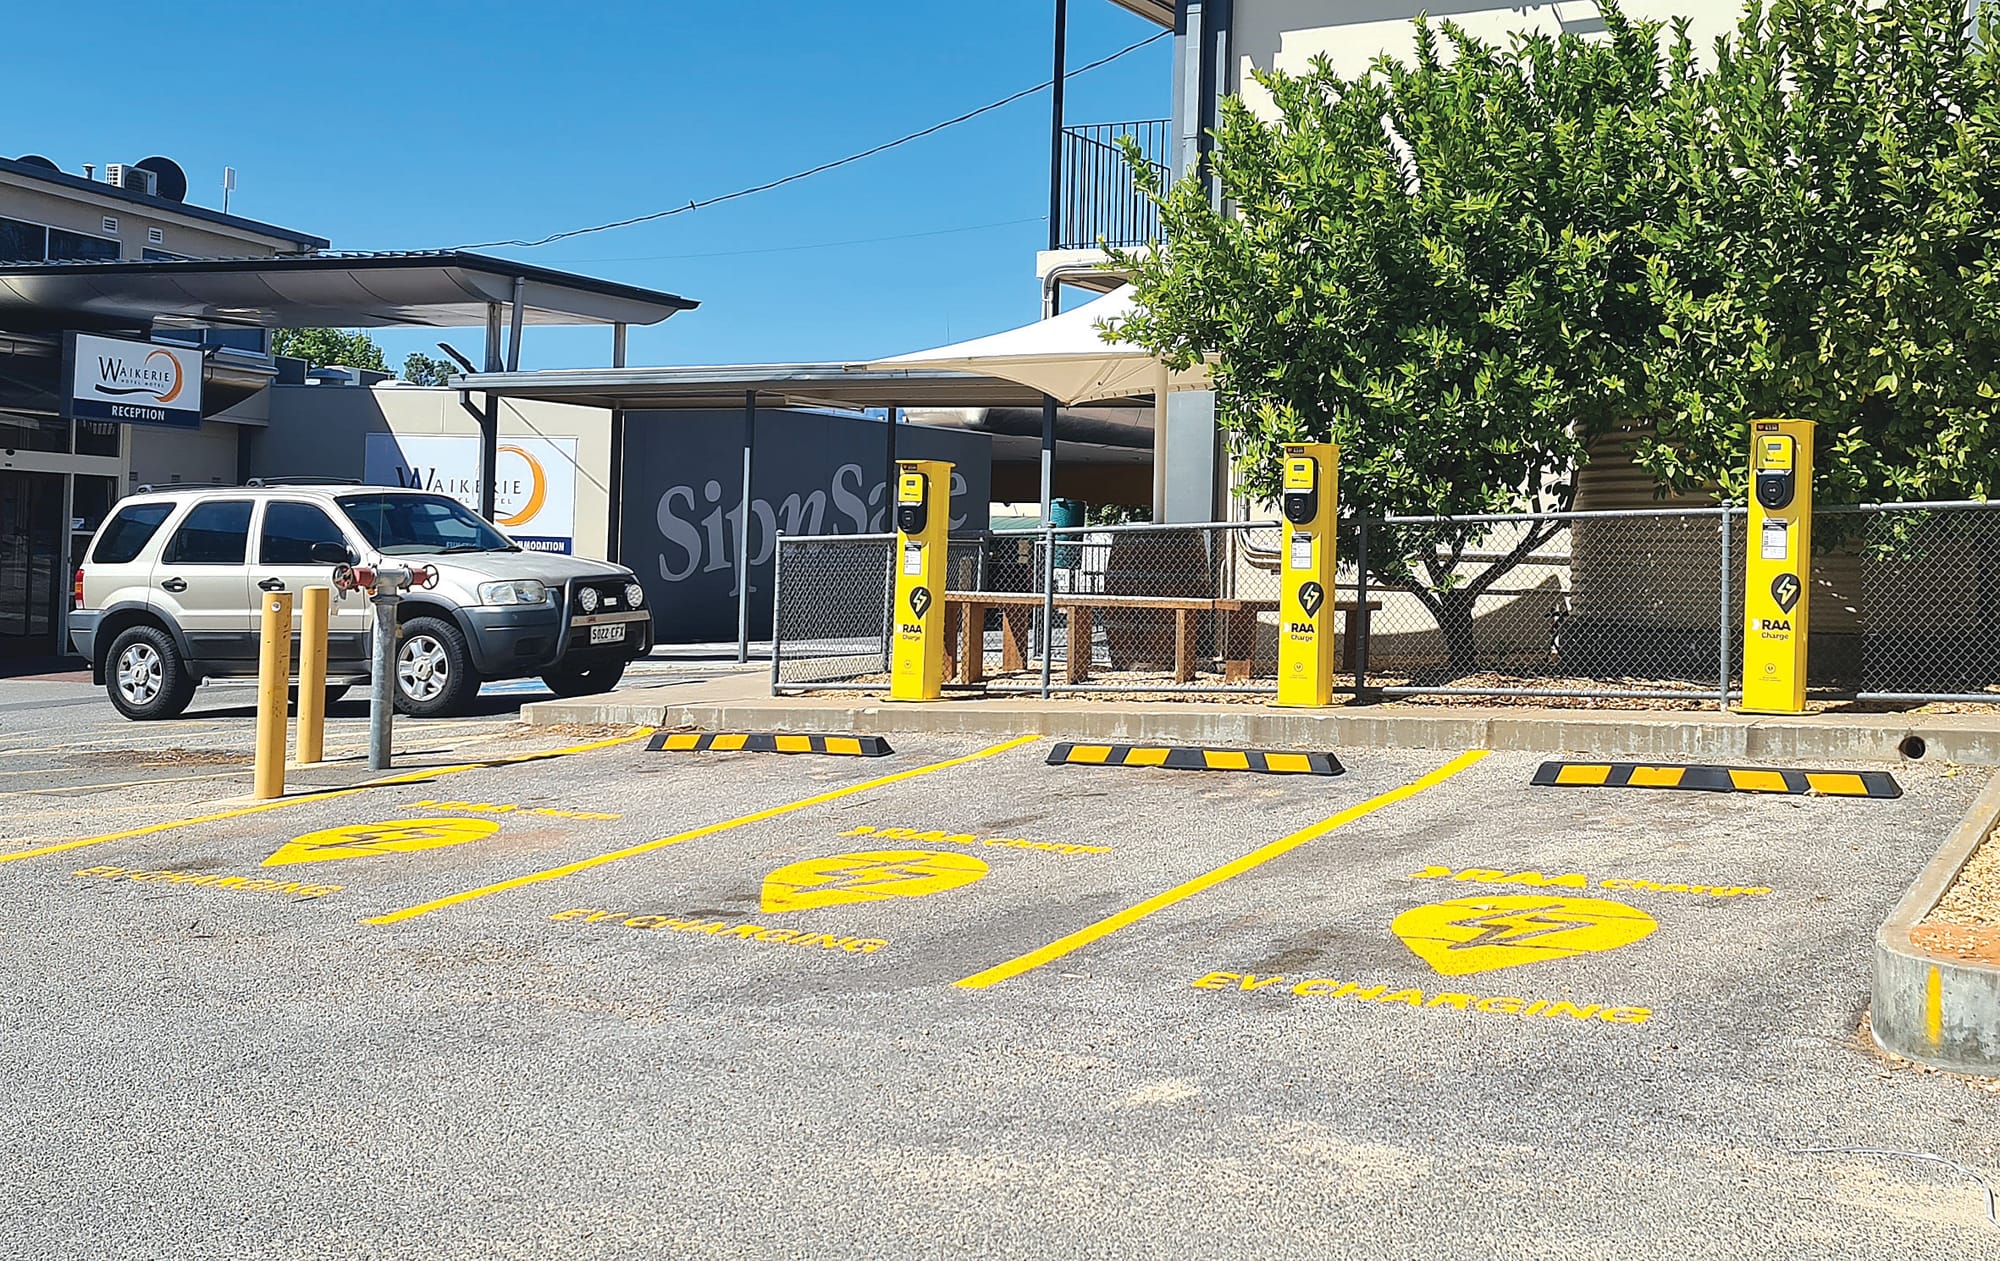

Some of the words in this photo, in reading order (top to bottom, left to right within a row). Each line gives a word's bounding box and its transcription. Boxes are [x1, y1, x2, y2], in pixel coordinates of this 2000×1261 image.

[98, 356, 169, 382] WAIKERIE
[112, 405, 165, 420] RECEPTION
[657, 463, 967, 597] SipnSae
[902, 624, 922, 633] RAA
[1291, 623, 1315, 633] RAA
[1762, 619, 1791, 630] RAA
[1291, 634, 1313, 642] Charge
[1761, 631, 1789, 640] Charge
[550, 908, 629, 922] EV
[624, 915, 888, 953] CHARGING
[1191, 970, 1285, 990] EV
[1292, 978, 1654, 1023] CHARGING
